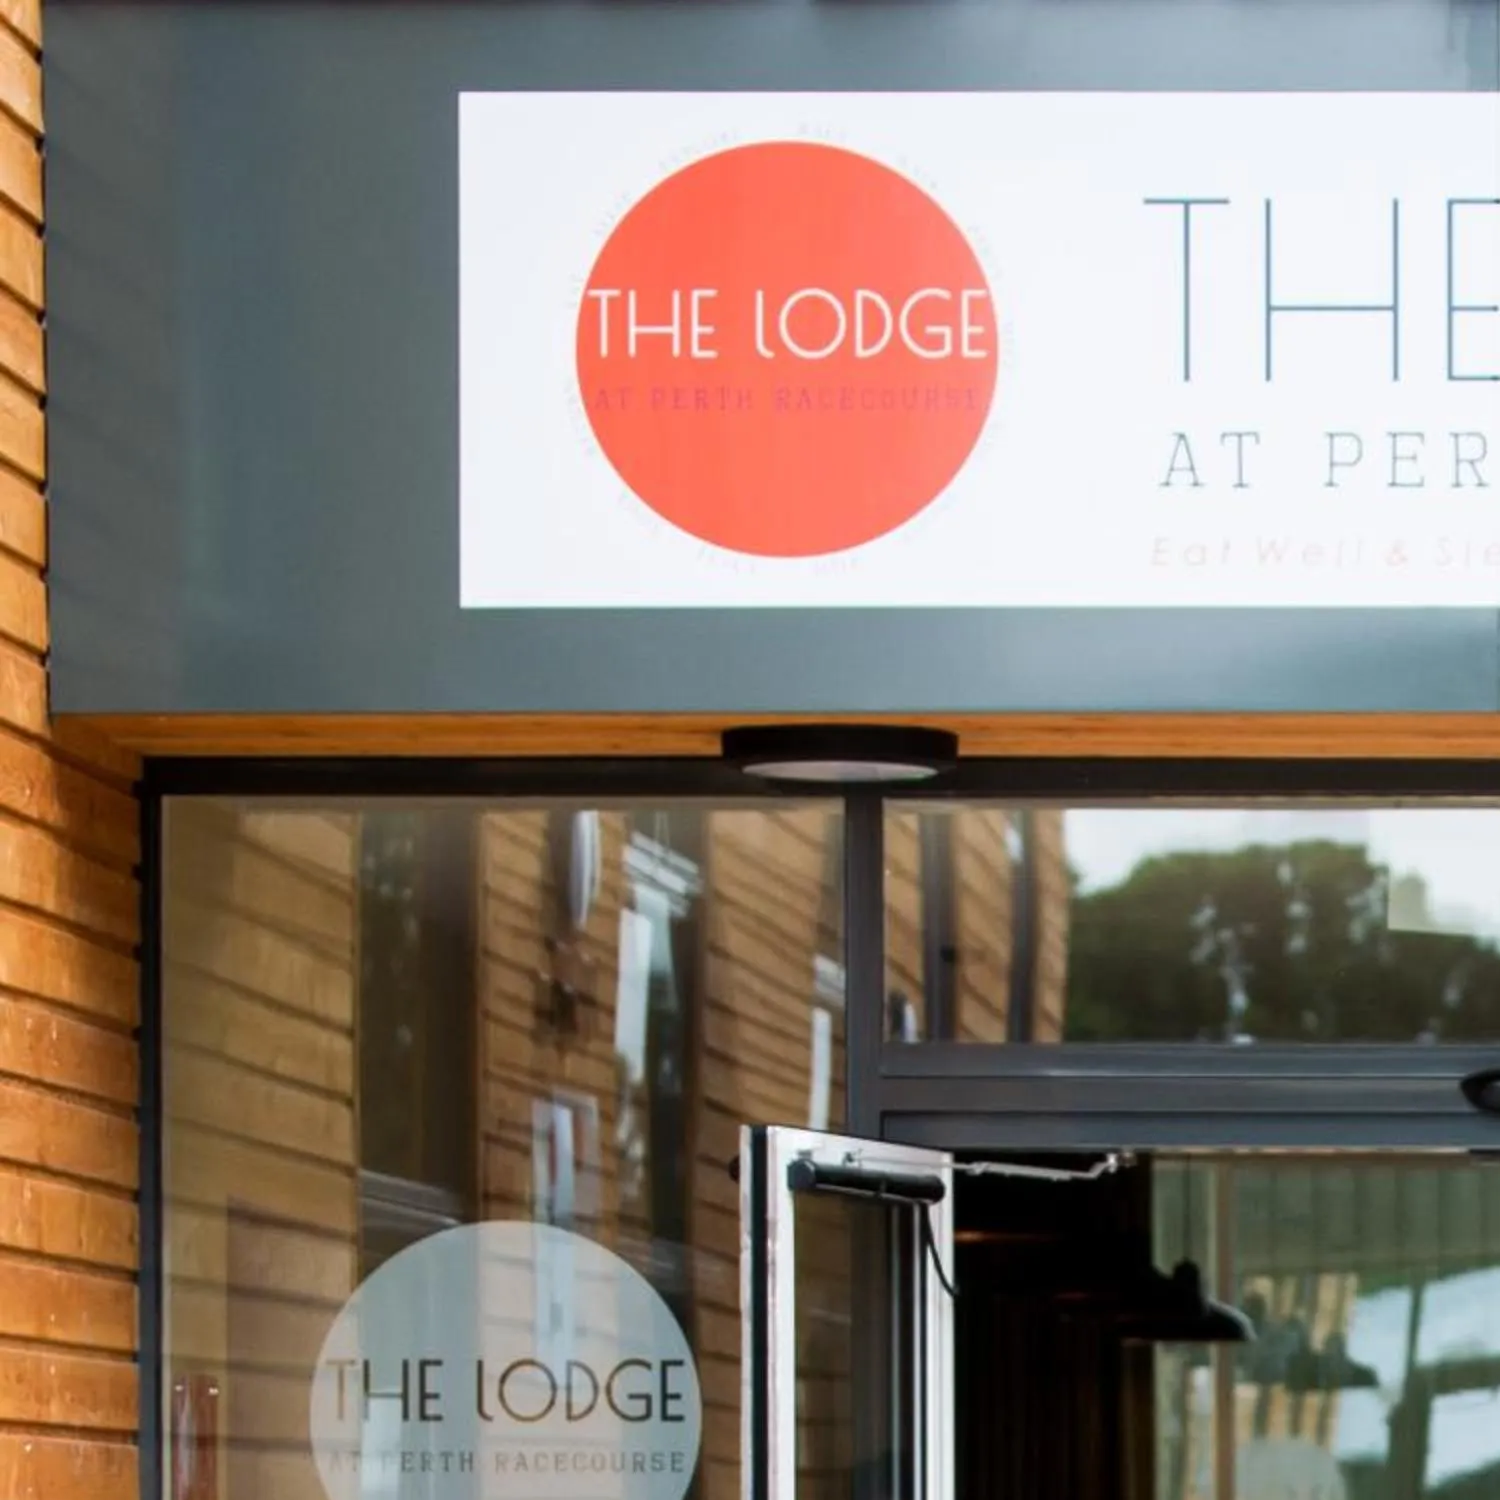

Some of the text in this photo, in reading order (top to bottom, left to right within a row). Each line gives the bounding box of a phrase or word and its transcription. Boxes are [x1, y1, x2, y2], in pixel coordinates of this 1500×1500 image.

[587, 288, 719, 359] THE
[756, 287, 990, 359] LODGE
[594, 387, 631, 411] AT
[651, 387, 755, 411] PERTH
[1158, 431, 1261, 489] AT
[1149, 537, 1231, 567] Eat
[1383, 538, 1411, 567] &
[326, 1358, 686, 1422] THE LODGE
[329, 1450, 687, 1475] AT PERTH RACECOURSE
